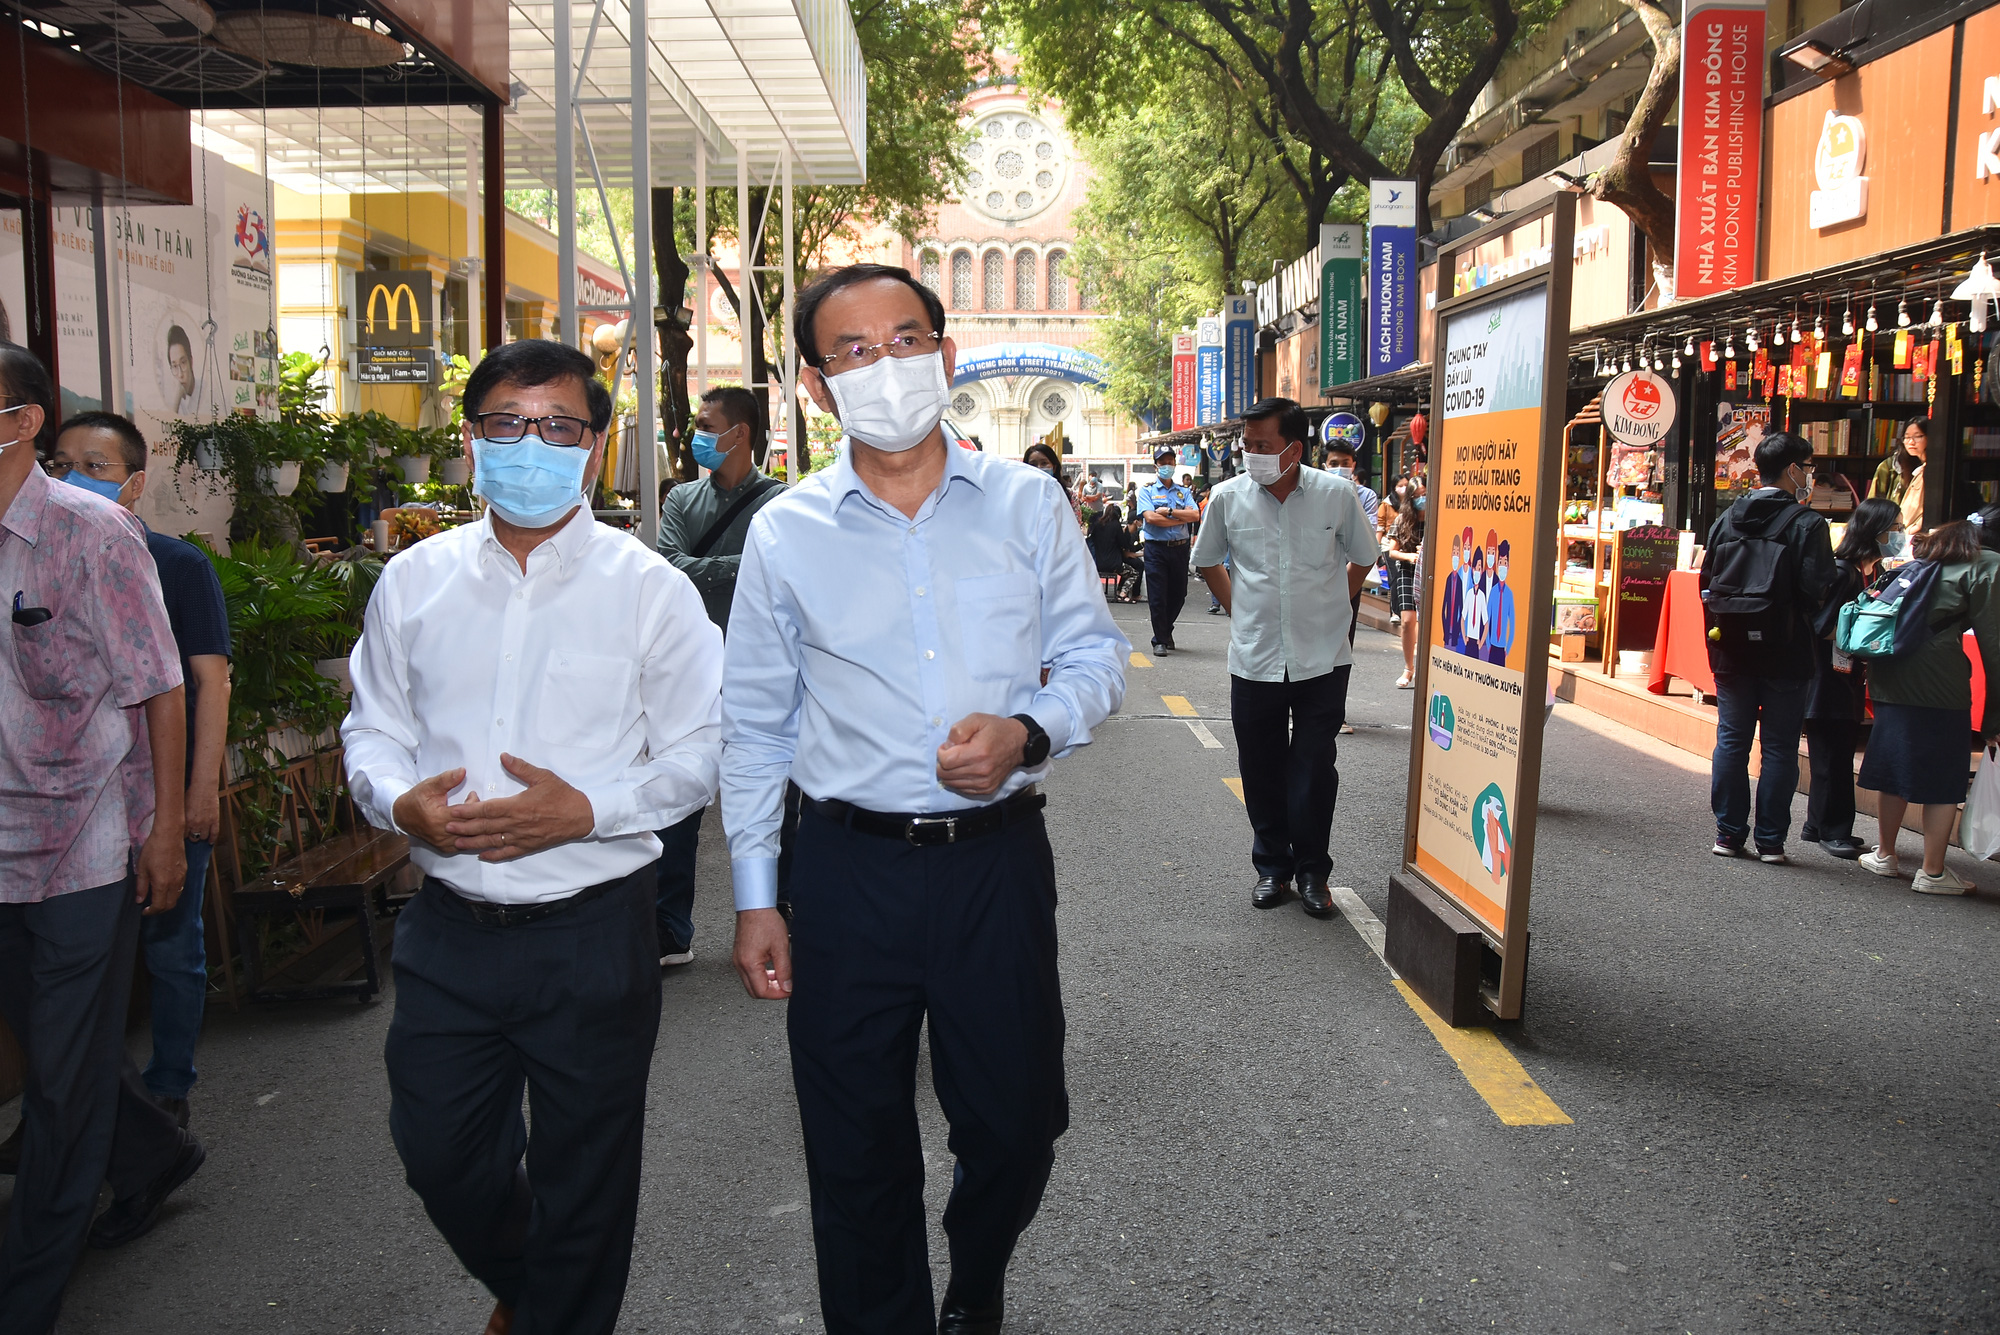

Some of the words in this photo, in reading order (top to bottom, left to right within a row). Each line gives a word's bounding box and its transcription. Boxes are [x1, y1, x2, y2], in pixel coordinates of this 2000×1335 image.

[1700, 24, 1723, 86] ĐỒNG
[1731, 24, 1748, 84] HOUSE
[1704, 91, 1721, 128] KIM
[1727, 90, 1746, 189] PUBLISHING
[1698, 135, 1719, 175] BẢN
[1697, 180, 1718, 236] XUẤT
[1724, 194, 1741, 248] DONG
[62, 232, 86, 252] RIÊNG
[154, 227, 193, 260] THÂN
[1573, 223, 1610, 259] AM
[1382, 242, 1392, 271] NAM
[1397, 252, 1406, 280] BOOK
[1696, 243, 1714, 284] NHÀ
[1722, 254, 1738, 286] KIM
[1282, 243, 1321, 317] MINH
[1380, 272, 1392, 326] PHƯƠNG
[1396, 284, 1404, 308] NAM
[1337, 300, 1348, 329] NAM
[1336, 332, 1348, 360] NHÃ
[1380, 328, 1391, 363] SÁCH
[1396, 310, 1404, 353] PHUONG
[966, 364, 976, 372] TO
[976, 360, 996, 371] HCMC
[998, 358, 1016, 367] BOOK
[1020, 358, 1044, 367] STREET
[1200, 352, 1212, 368] TRẺ
[1448, 346, 1472, 366] CHUNG
[1472, 342, 1488, 360] TAY
[1200, 368, 1212, 385] BẢN
[1446, 366, 1460, 388] ĐẨY
[1460, 365, 1472, 385] LÙI
[1200, 386, 1212, 406] XUẤT
[1446, 386, 1485, 412] COVID-19
[1200, 406, 1212, 424] NHÀ
[1613, 414, 1633, 435] KIM
[1328, 427, 1360, 438] BOO
[1456, 446, 1470, 467] MỌI
[1471, 439, 1497, 462] NGƯỜI
[1498, 438, 1518, 460] HÃY
[1454, 470, 1467, 486] ĐEO
[1468, 461, 1490, 486] KHẨU
[1491, 468, 1521, 486] TRANG
[1445, 494, 1456, 510] KHI
[1457, 487, 1470, 510] ĐẾN
[1472, 490, 1502, 512] ĐƯỜNG
[1504, 490, 1531, 513] SÁCH
[1432, 656, 1442, 670] THỰC
[1443, 660, 1453, 674] HIỆN
[1453, 662, 1464, 678] RỬA
[1464, 668, 1474, 681] TAY
[1474, 672, 1500, 690] THƯỜNG
[1500, 680, 1522, 697] XUYÊN
